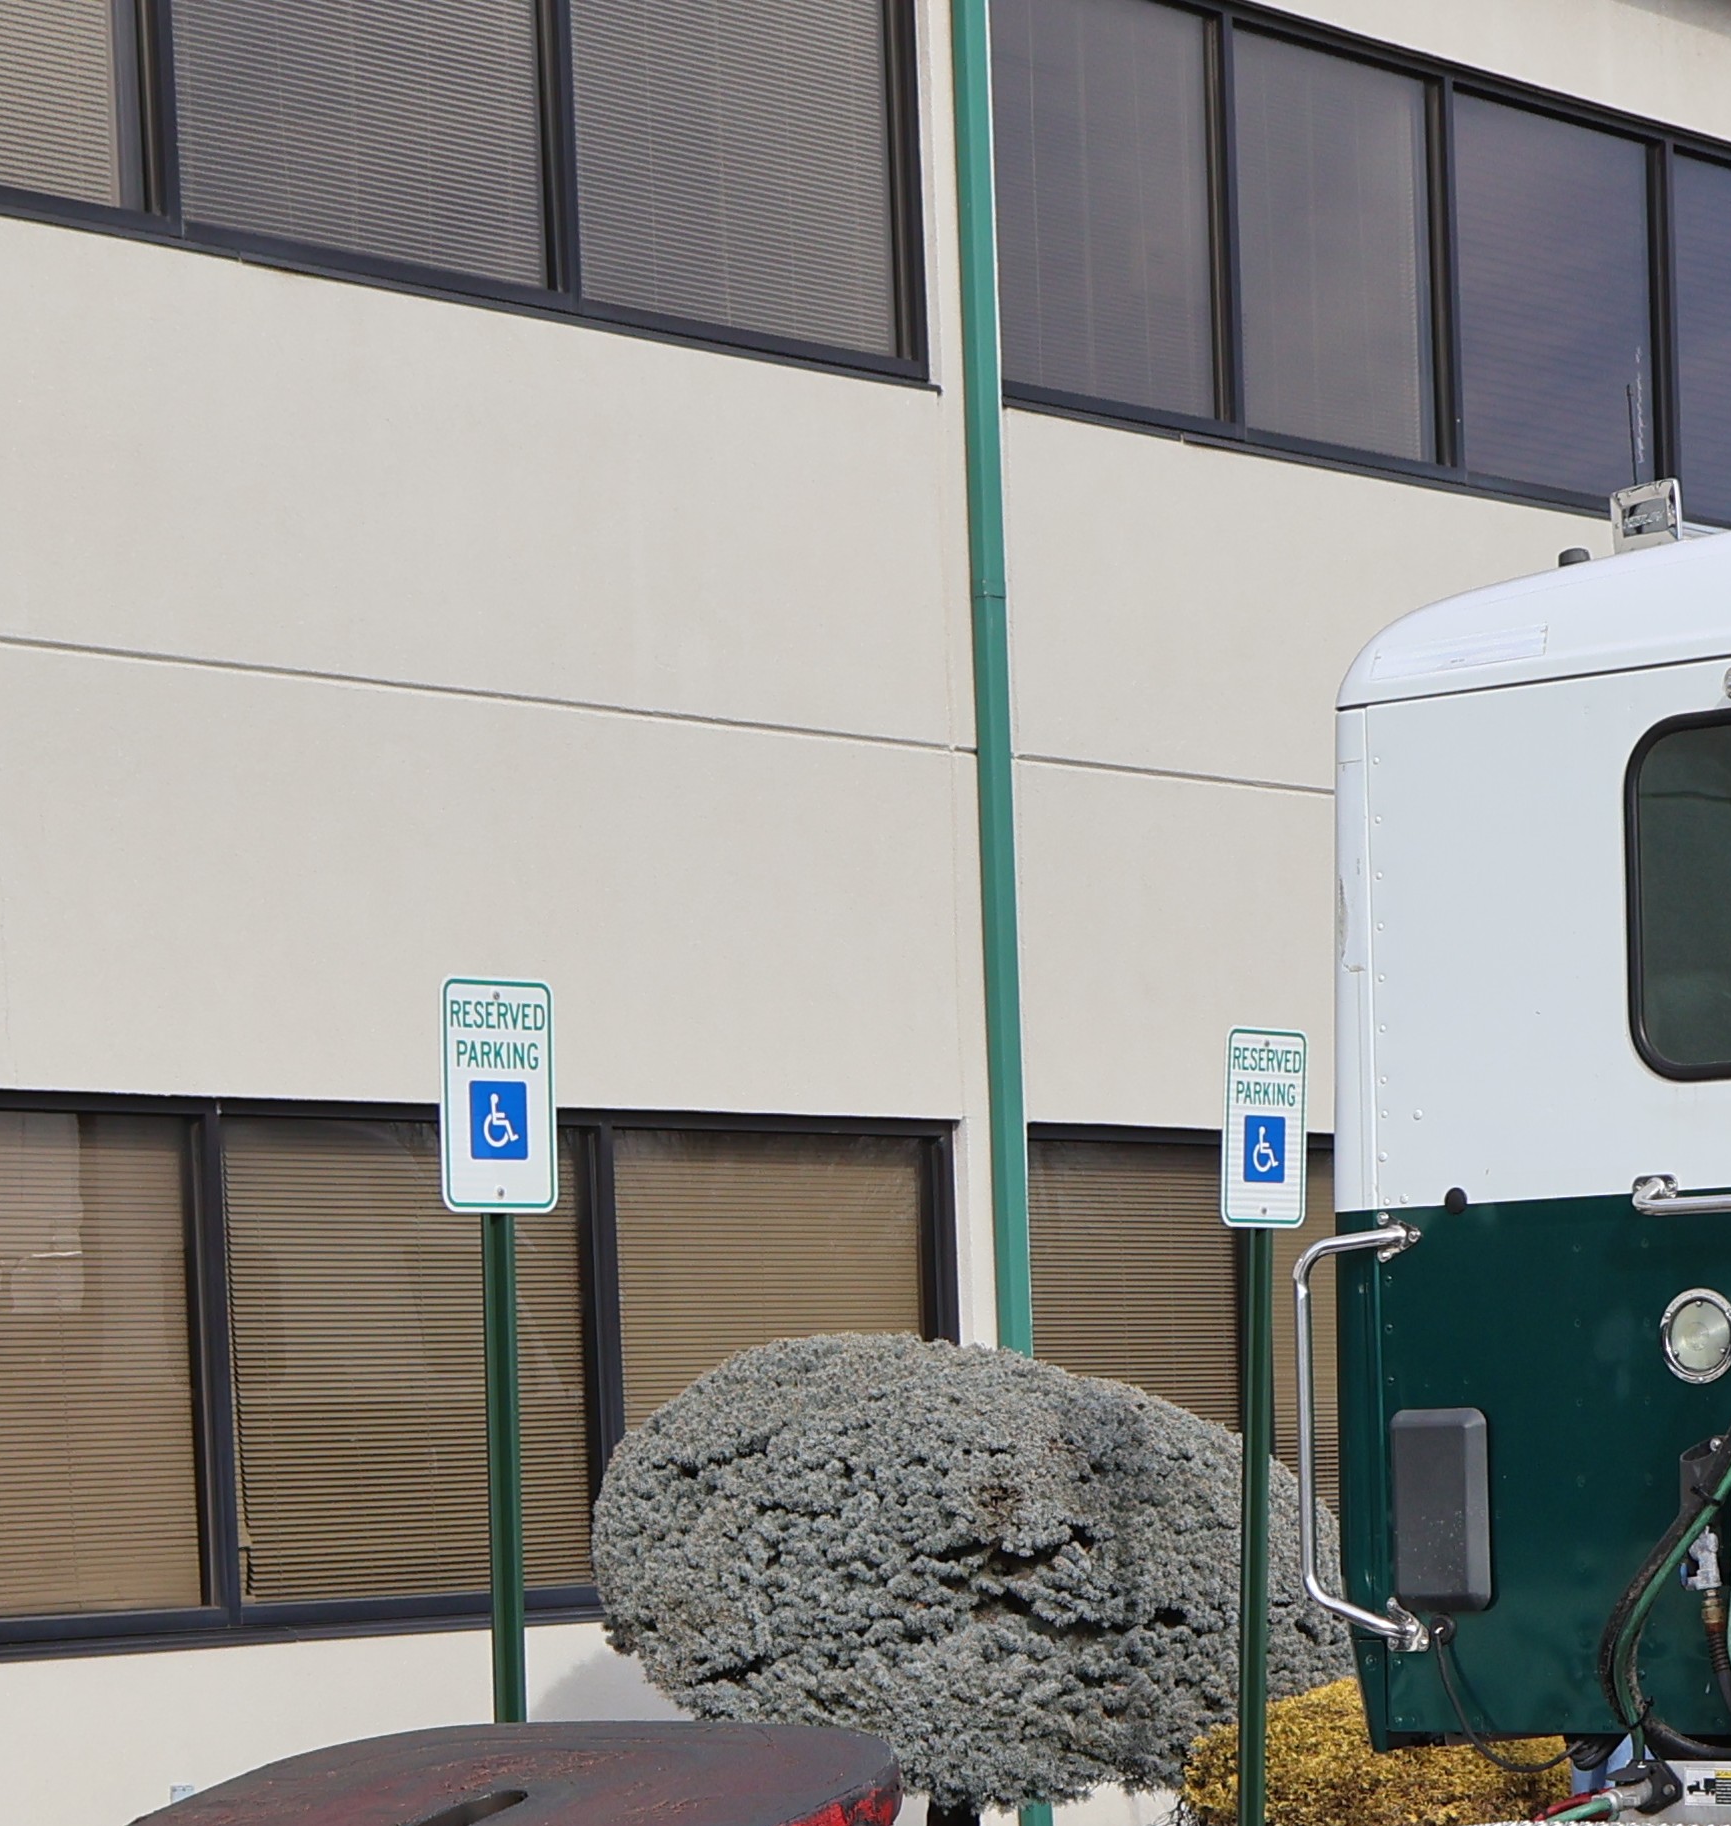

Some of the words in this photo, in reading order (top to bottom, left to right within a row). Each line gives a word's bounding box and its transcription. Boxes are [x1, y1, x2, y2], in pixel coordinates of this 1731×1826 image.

[450, 1000, 545, 1031] RESERVED
[456, 1040, 539, 1070] PARKING
[1232, 1047, 1301, 1074] RESERVED
[1235, 1081, 1296, 1107] PARKING
